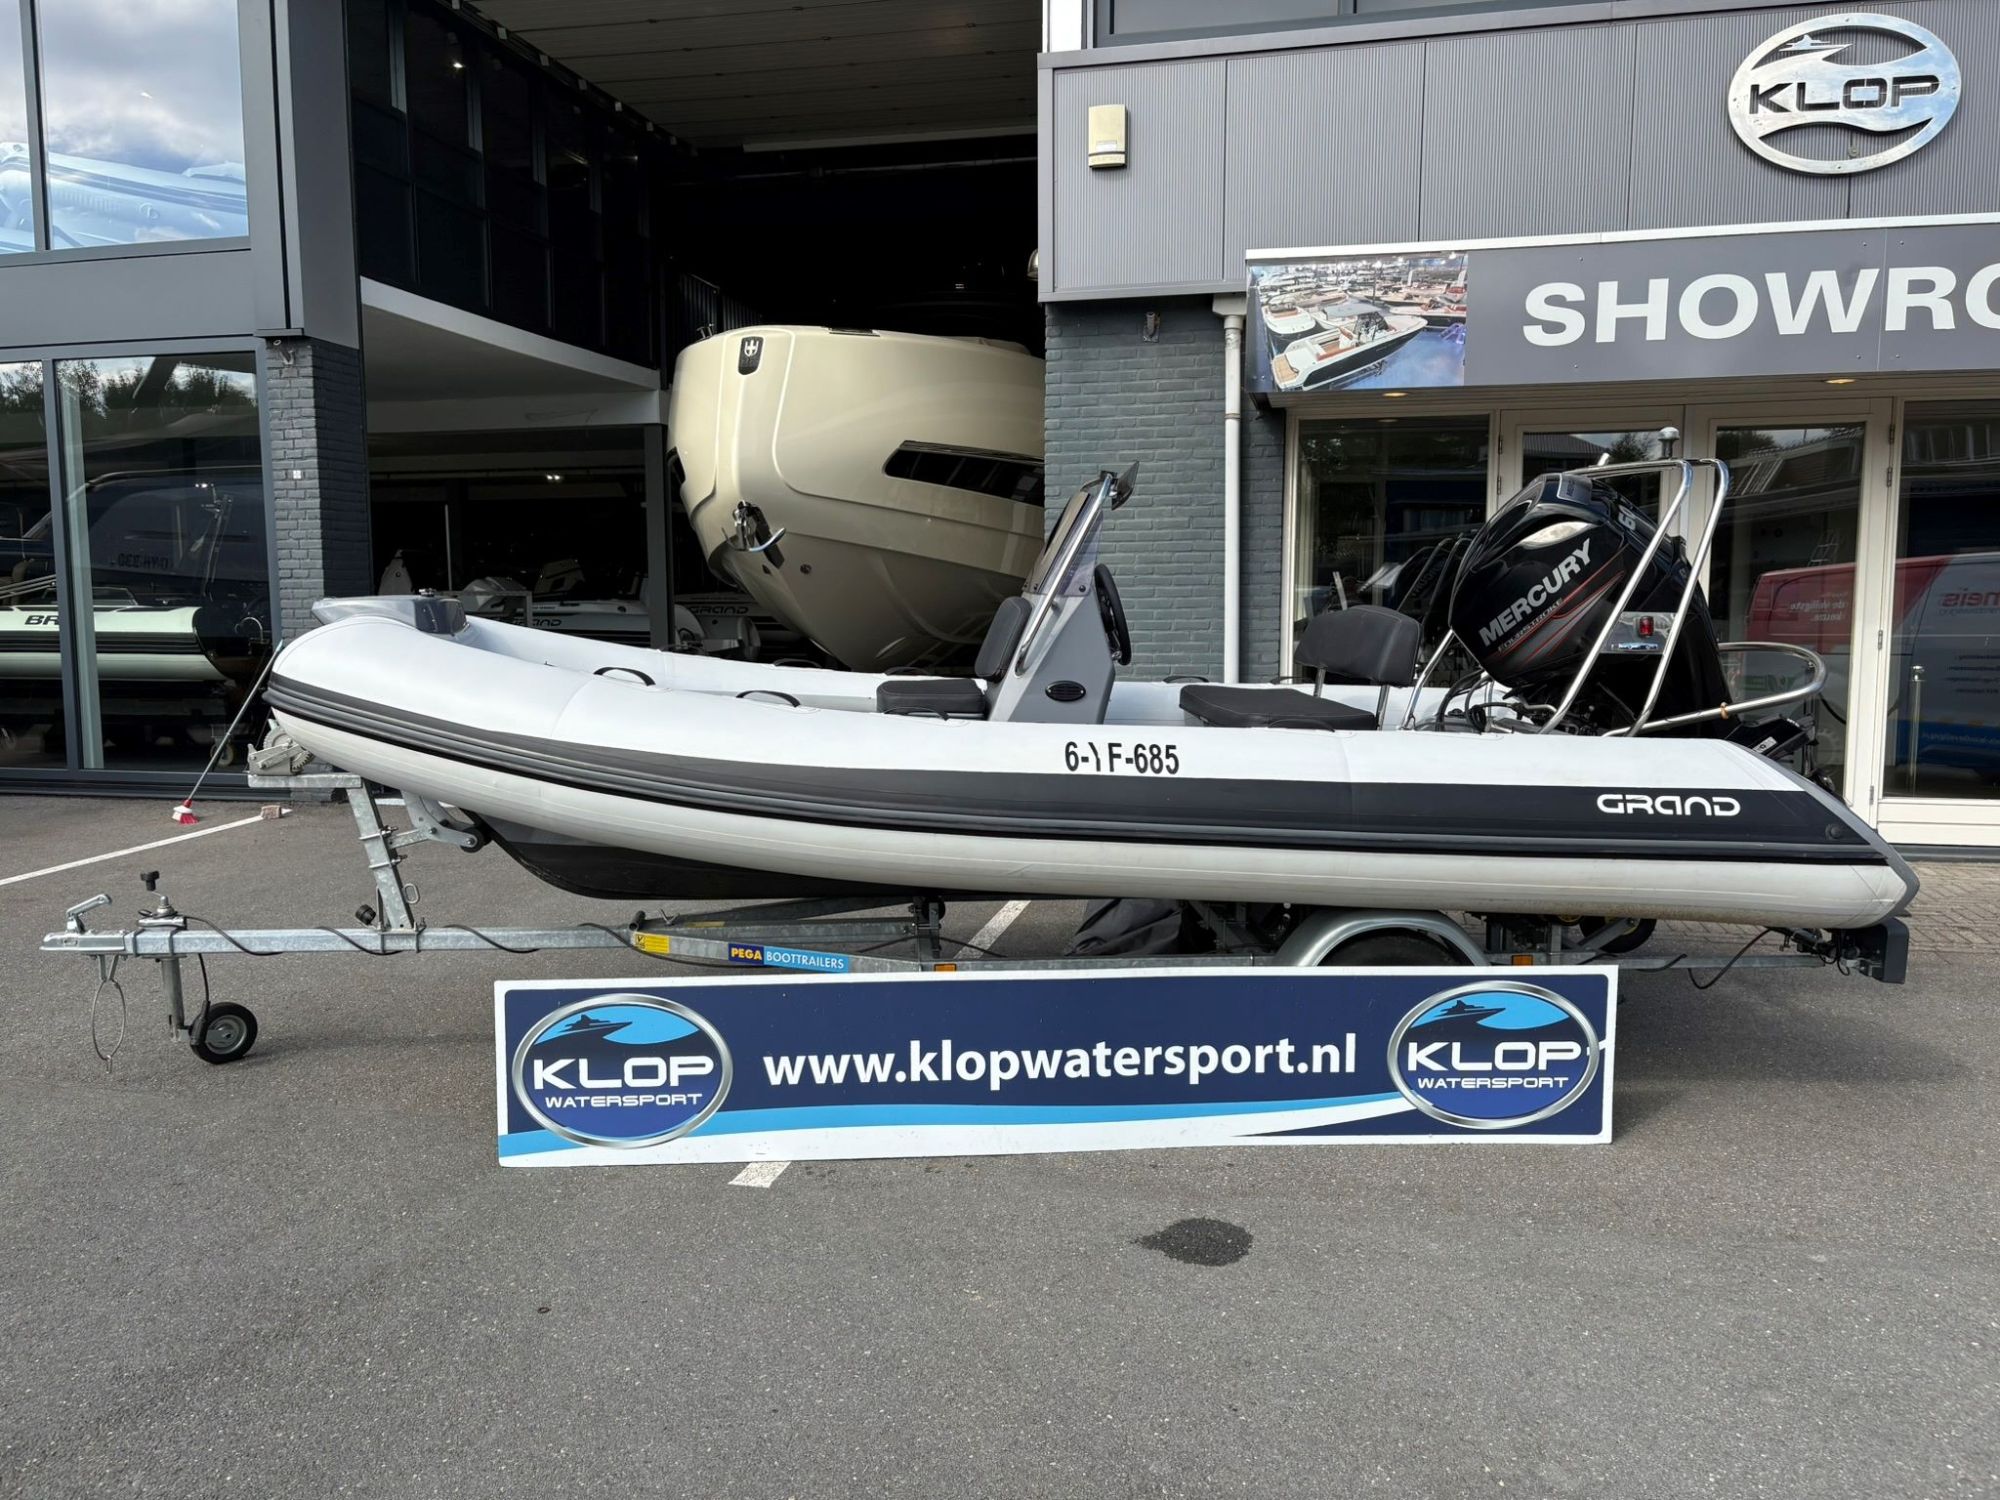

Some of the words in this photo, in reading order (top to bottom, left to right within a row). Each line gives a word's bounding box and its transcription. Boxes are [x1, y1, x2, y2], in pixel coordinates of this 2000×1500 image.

[1749, 74, 1940, 114] KLOP
[1478, 538, 1592, 648] MERCURY
[690, 606, 749, 615] GRAND
[1498, 597, 1562, 652] FOURSTROKE
[1597, 793, 1741, 817] GRAND
[731, 947, 763, 962] PEGA
[766, 950, 845, 970] BOOTTRAILERS
[763, 1033, 1356, 1090] www.klopwatersport.nl
[1407, 1041, 1582, 1071] KLOP
[534, 1055, 714, 1090] KLOP
[1417, 1077, 1569, 1089] WATERSPORT
[545, 1093, 703, 1109] WATERSPORT
